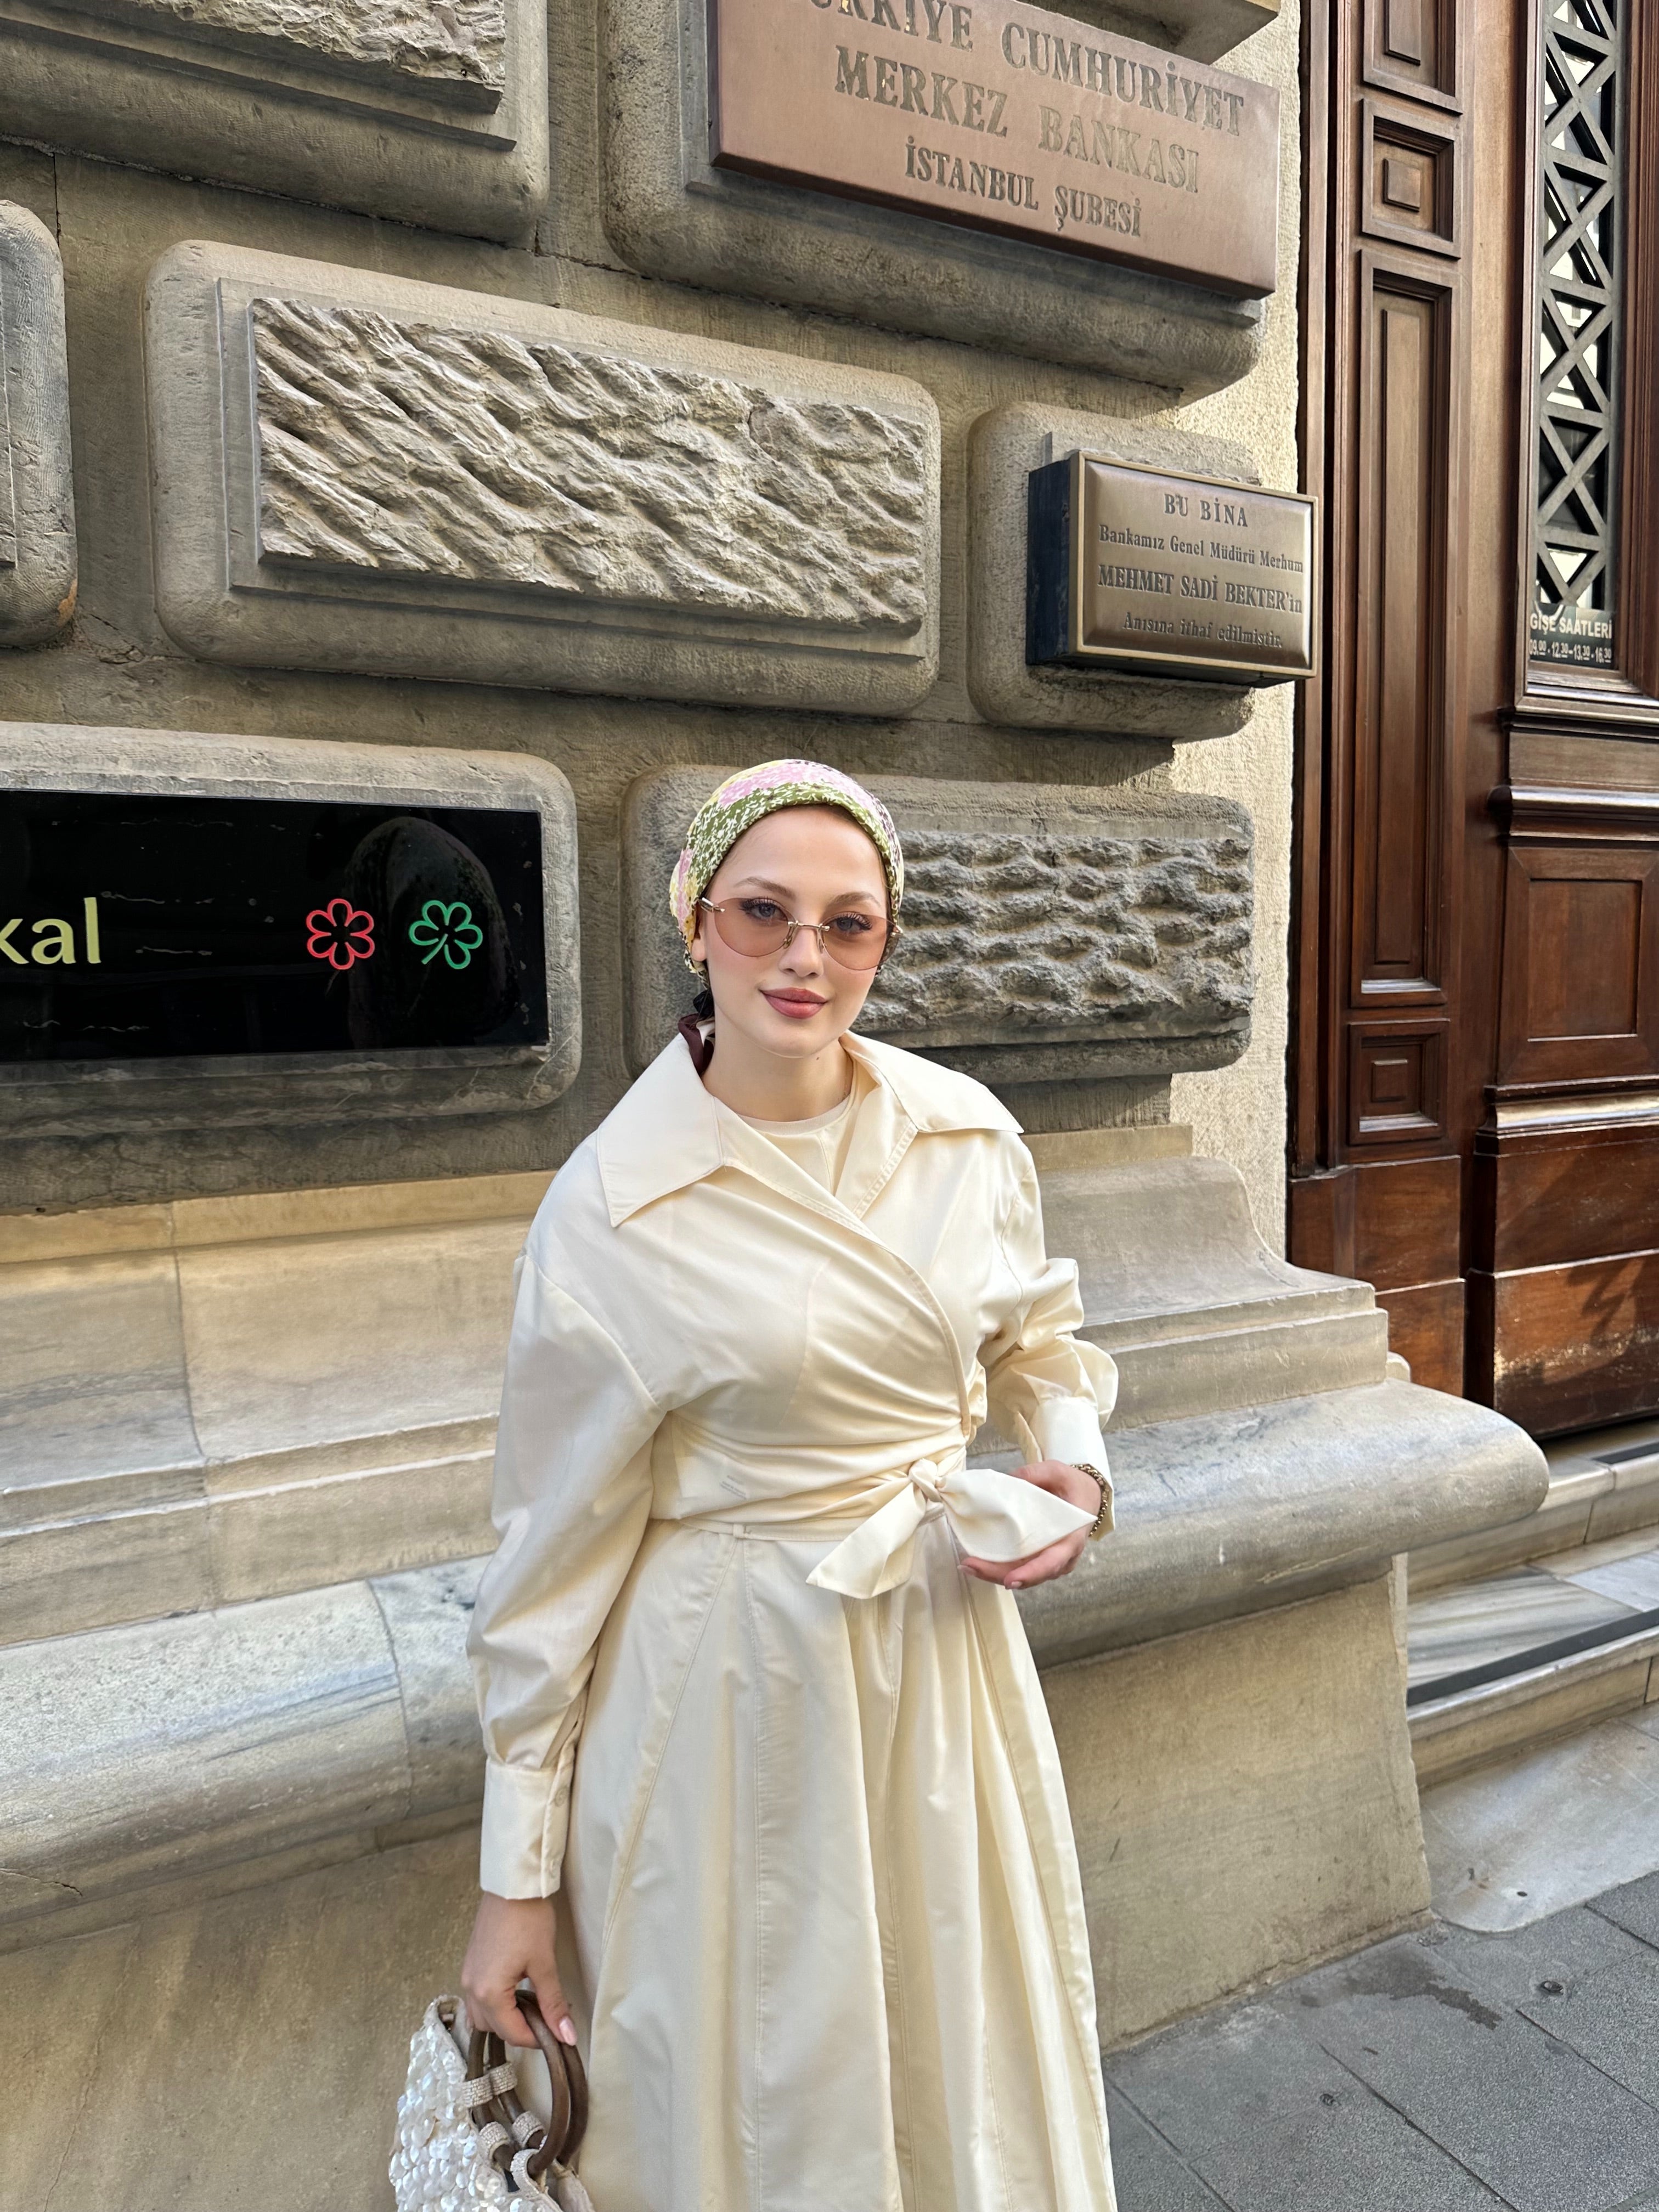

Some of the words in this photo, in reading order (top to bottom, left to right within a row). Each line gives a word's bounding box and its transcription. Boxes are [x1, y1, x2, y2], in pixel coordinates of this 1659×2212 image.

[811, 0, 973, 52] KİYE
[1001, 21, 1244, 137] CUMHURİYET
[835, 45, 1008, 138] MERKEZ
[1039, 105, 1199, 194] BANKASI
[905, 136, 1039, 211] İSTANBUL
[1054, 185, 1142, 237] ŞUBESİ
[1200, 497, 1248, 527] BİNA
[1099, 524, 1164, 550] Bankamız
[1170, 535, 1204, 556] Genel
[1210, 542, 1255, 564] Müdürü
[1260, 550, 1304, 573] Merhum
[1098, 565, 1174, 595] MEHMET
[1180, 575, 1218, 601] SADİ
[1225, 582, 1302, 614] BEKTER'in
[1123, 612, 1174, 634] Anısına
[1181, 619, 1213, 639] ithaf
[1217, 625, 1283, 648] edilmiştir.
[1559, 617, 1612, 639] SAATLERİ
